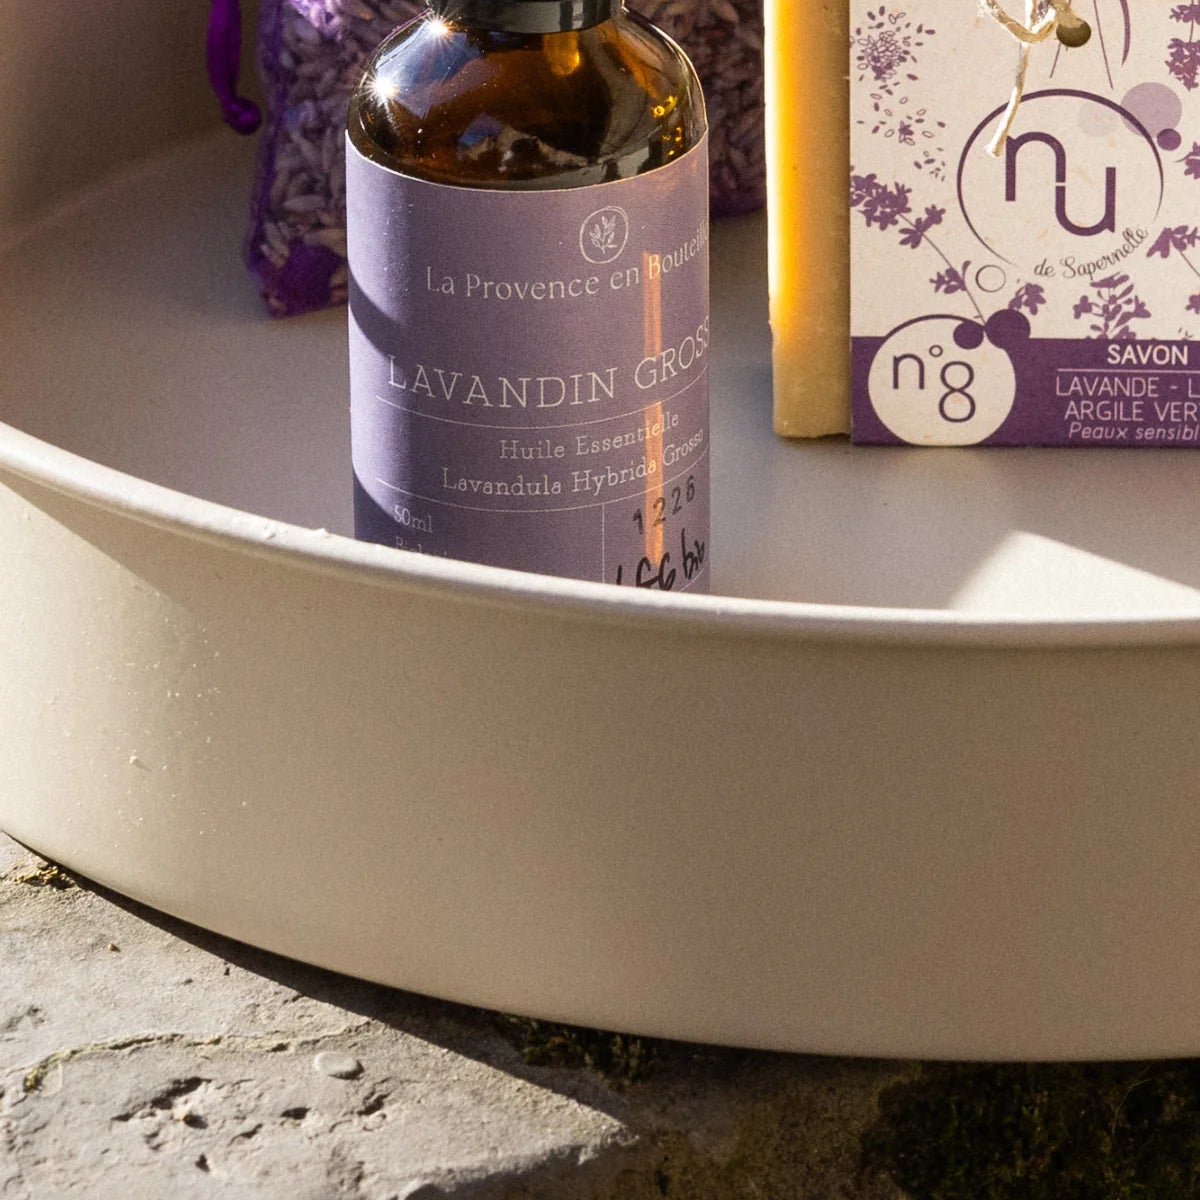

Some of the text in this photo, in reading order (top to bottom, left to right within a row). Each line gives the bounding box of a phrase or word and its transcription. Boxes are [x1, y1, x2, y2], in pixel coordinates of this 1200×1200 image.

[1005, 131, 1117, 237] nu
[1033, 226, 1149, 281] de Sapernelle
[426, 266, 456, 296] La
[466, 272, 601, 302] Provence
[610, 266, 640, 290] en
[1107, 344, 1189, 366] SAVON
[387, 353, 619, 409] LAVANDIN
[1055, 375, 1160, 398] LAVANDE
[1064, 400, 1145, 422] ARGILE
[499, 411, 680, 461] Huile Essentielle
[1068, 421, 1129, 440] Peaux
[441, 466, 563, 497] Lavandula
[570, 454, 657, 497] Hybrida
[393, 503, 434, 534] 50ml
